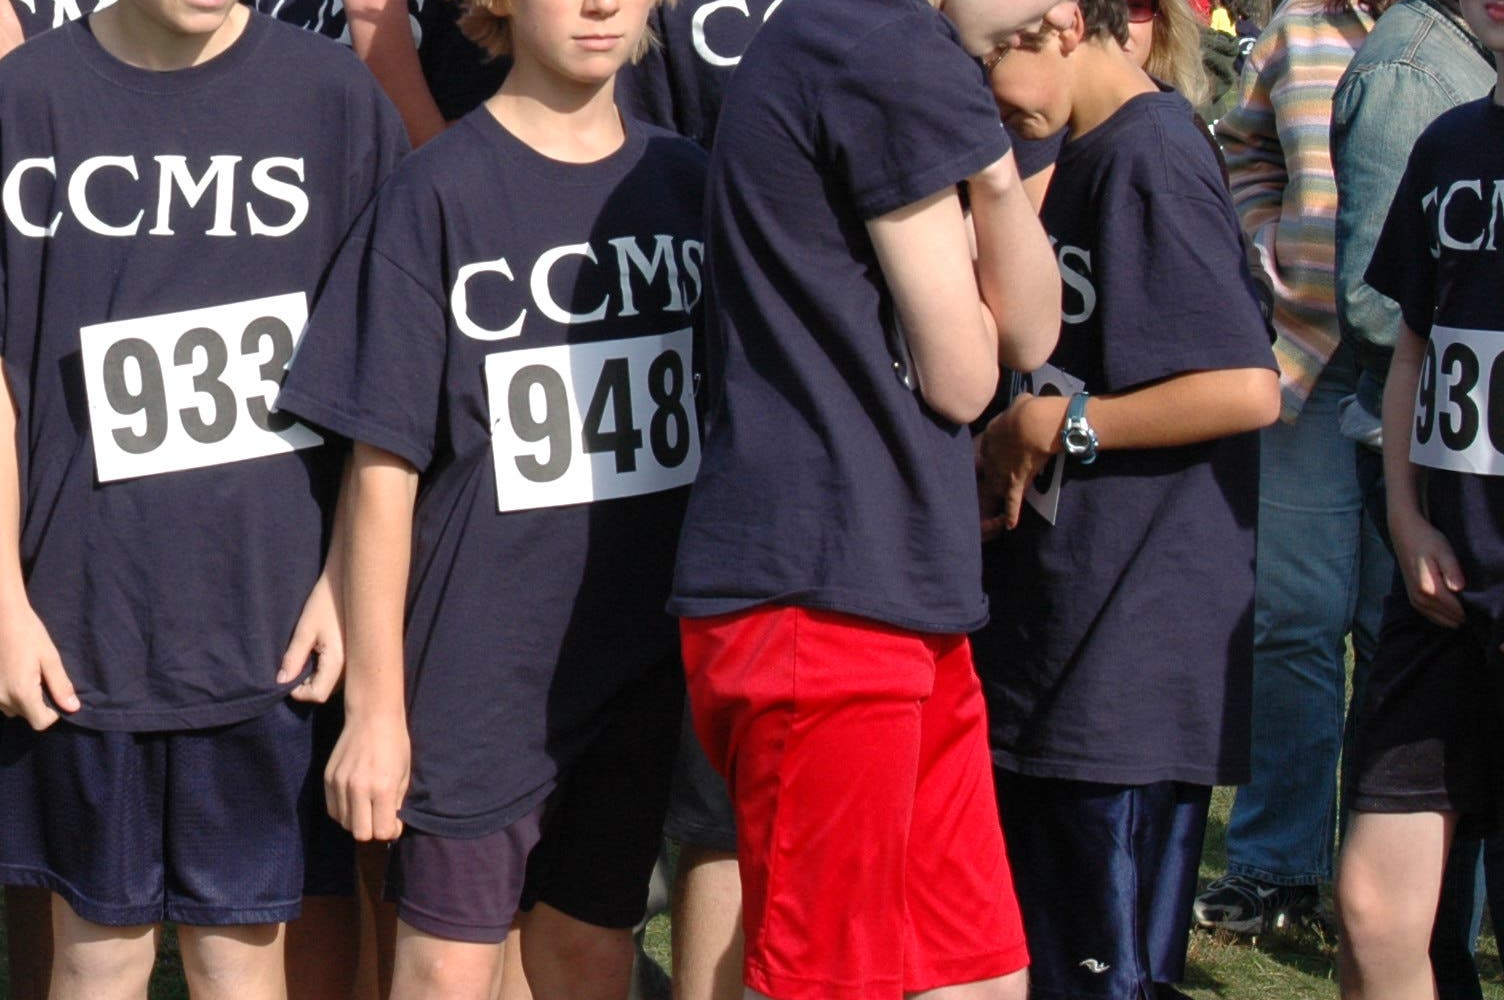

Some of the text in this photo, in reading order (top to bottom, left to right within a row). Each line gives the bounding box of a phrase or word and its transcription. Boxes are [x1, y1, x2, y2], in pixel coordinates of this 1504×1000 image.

[2, 154, 310, 237] CCMS
[450, 233, 705, 341] CCMS
[1051, 236, 1096, 325] S
[102, 315, 297, 456] 933
[506, 348, 691, 484] 948
